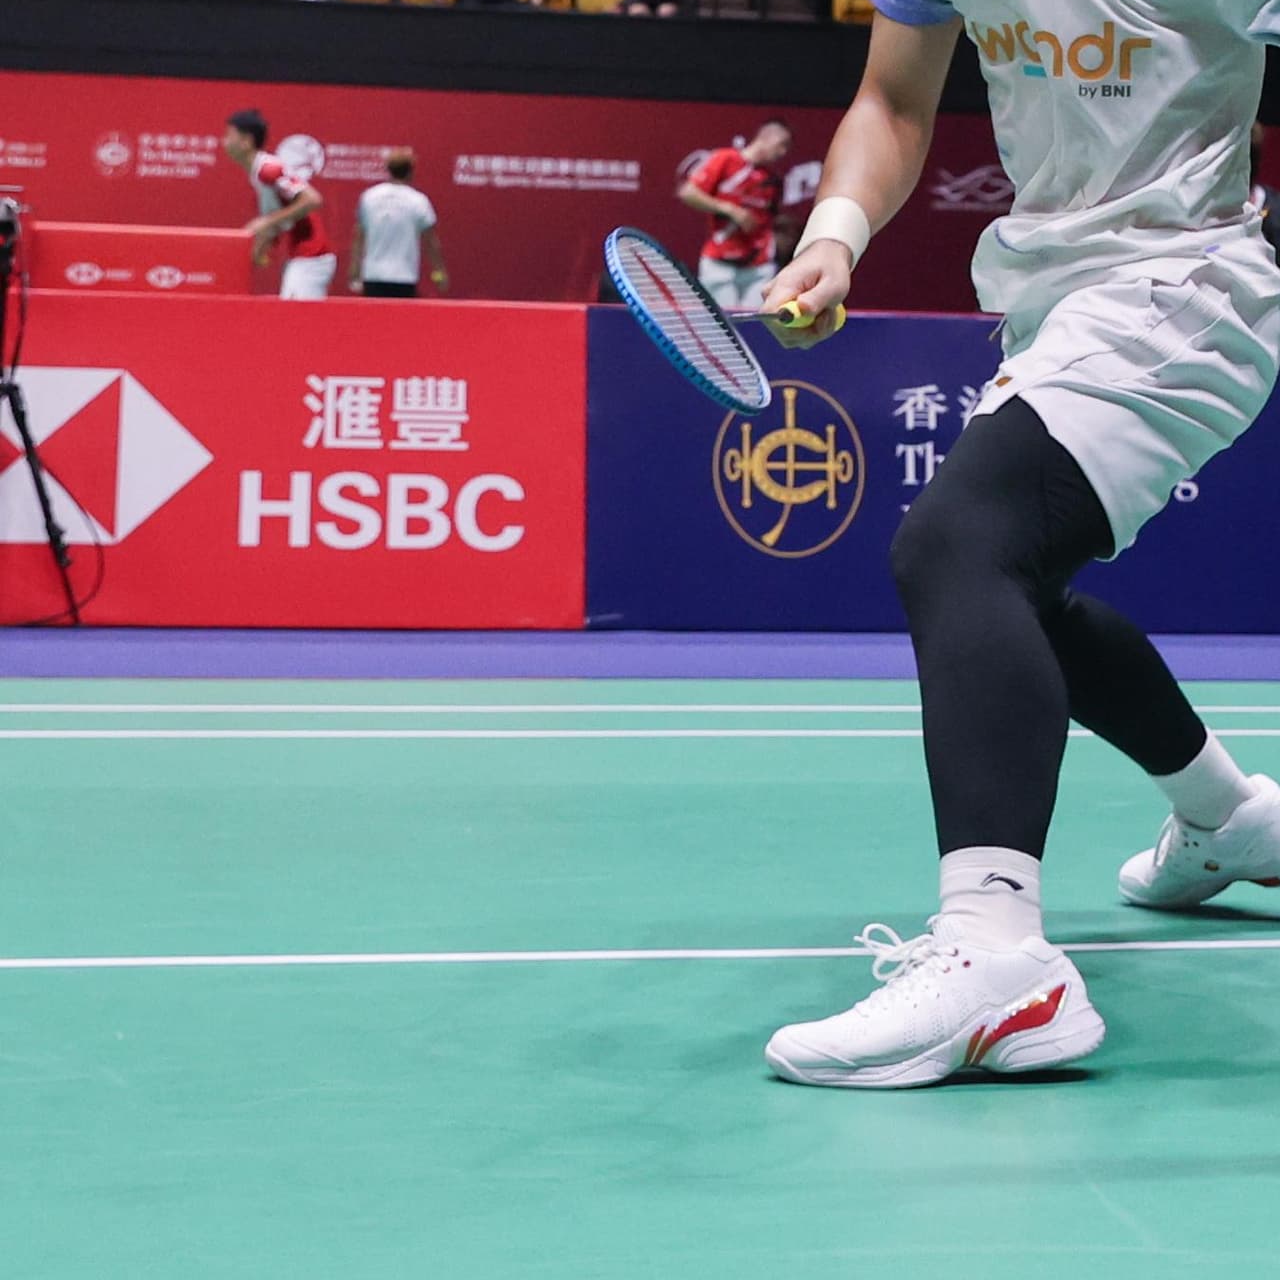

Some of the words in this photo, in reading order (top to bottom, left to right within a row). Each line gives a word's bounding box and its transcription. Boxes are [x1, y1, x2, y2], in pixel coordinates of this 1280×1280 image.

[1078, 84, 1098, 99] by
[1101, 84, 1132, 98] BNI
[896, 440, 946, 486] Th
[237, 469, 526, 552] HSBC
